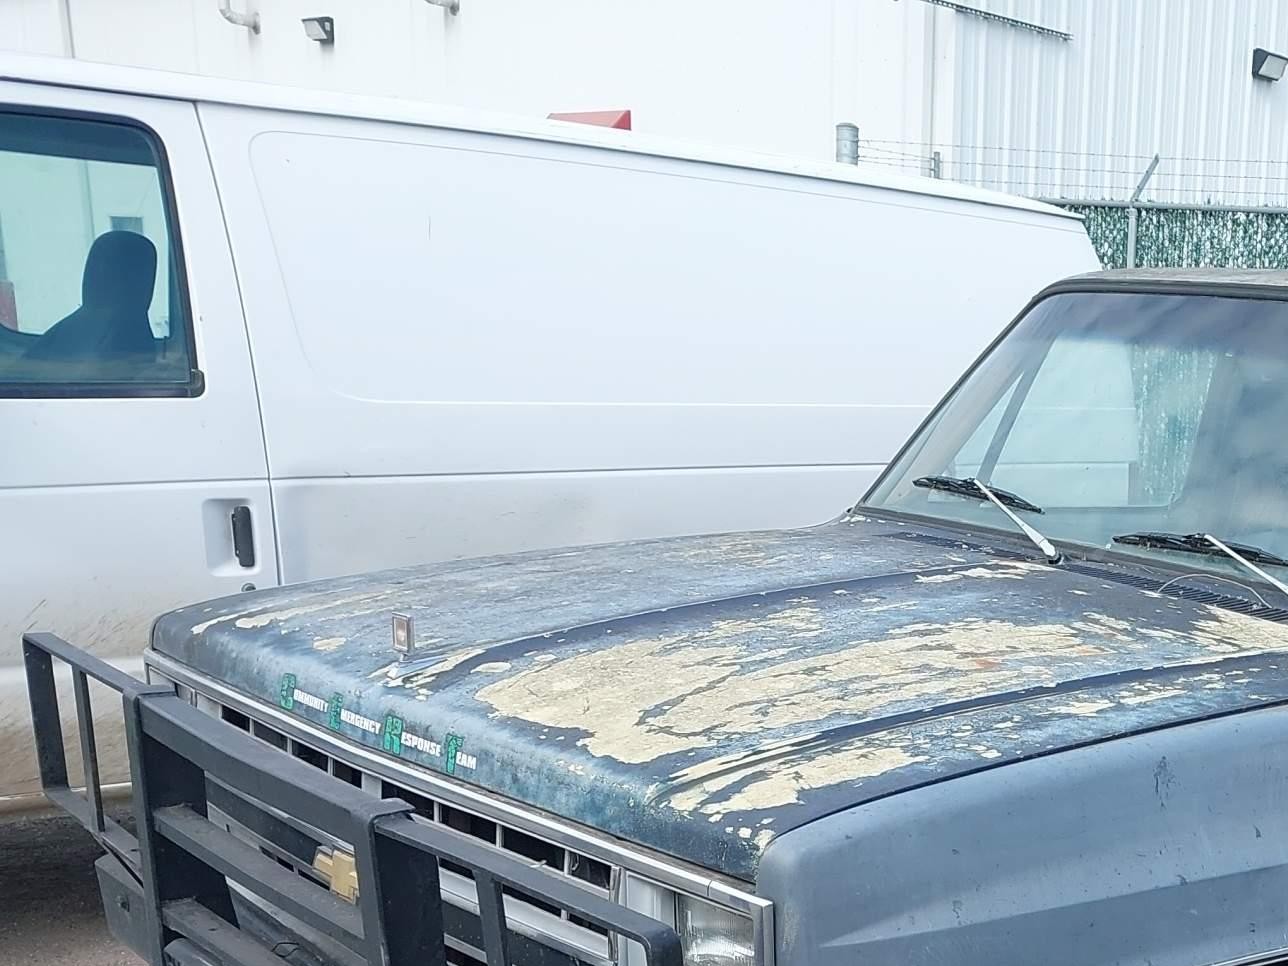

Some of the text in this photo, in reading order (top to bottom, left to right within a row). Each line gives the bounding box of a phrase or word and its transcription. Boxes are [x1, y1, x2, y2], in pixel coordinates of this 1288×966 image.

[328, 692, 382, 732] EMERGENCY
[382, 712, 442, 757] RESPONSE
[445, 731, 478, 775] TEAM
